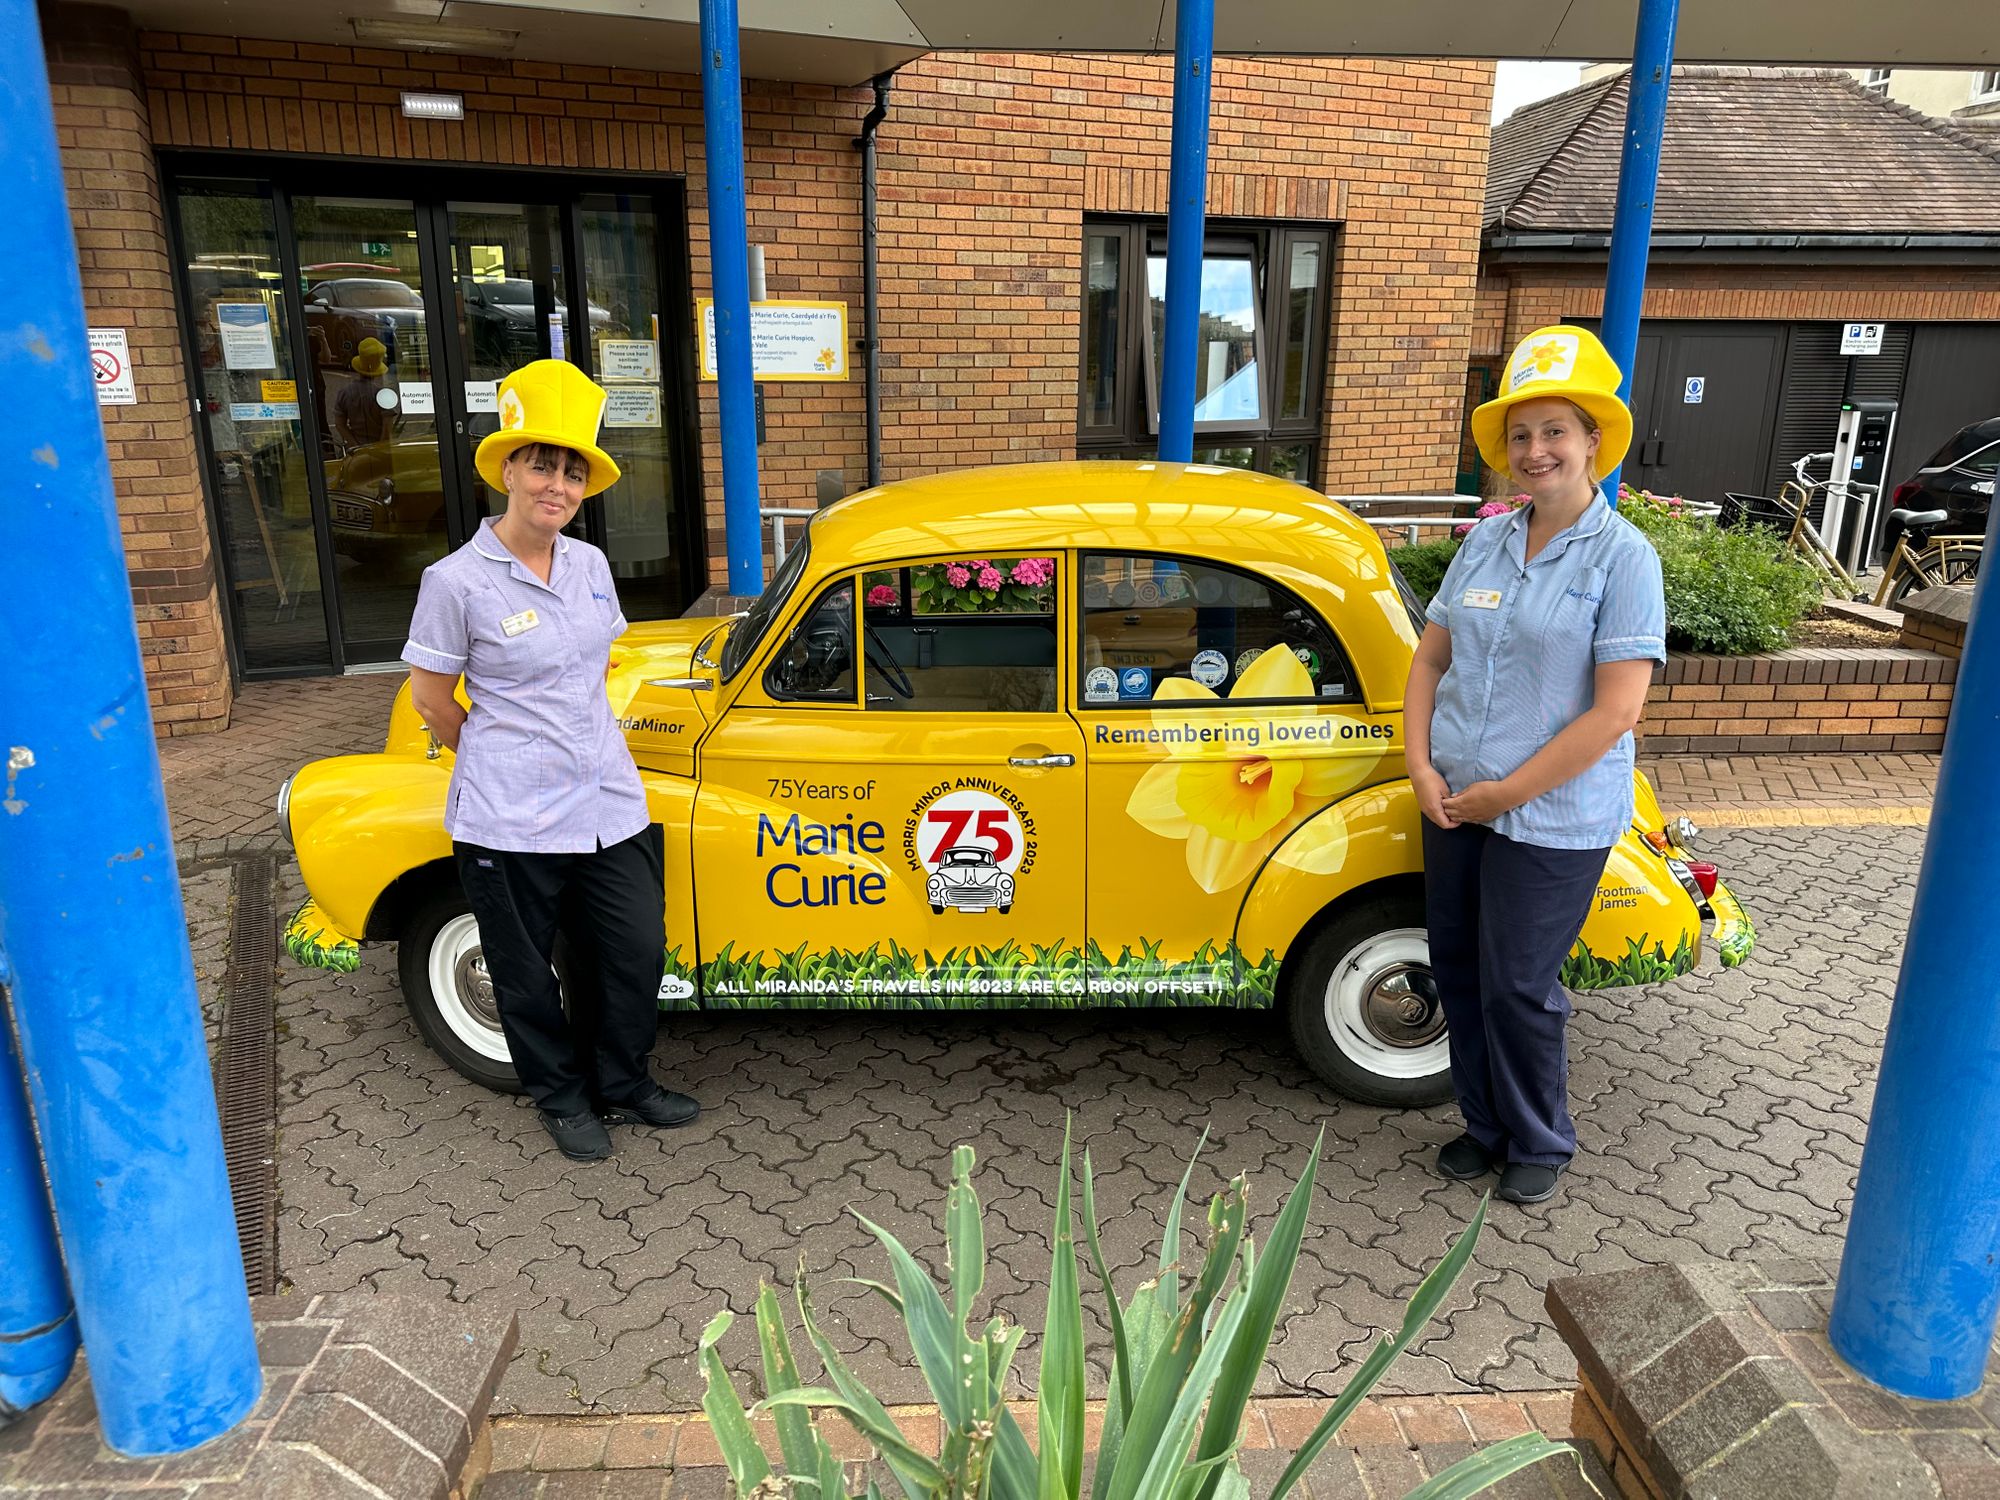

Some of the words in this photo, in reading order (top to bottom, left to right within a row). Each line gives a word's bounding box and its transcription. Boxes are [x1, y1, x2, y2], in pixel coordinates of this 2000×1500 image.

[1095, 722, 1260, 746] Remembering
[1269, 720, 1331, 741] loved
[1340, 723, 1394, 739] ones
[854, 780, 876, 800] of
[911, 781, 952, 816] MINOR
[955, 777, 1037, 837] ANNIVERSARY
[757, 813, 885, 857] Marie
[903, 818, 920, 872] MORRIS
[928, 810, 1013, 863] 75
[1020, 842, 1037, 874] 2023
[766, 863, 886, 908] Curie
[1597, 886, 1648, 898] Footman
[1598, 898, 1637, 912] James
[715, 981, 750, 993] ALL
[755, 980, 853, 993] MIRANDA'S
[861, 980, 941, 993] TRAVELS
[946, 981, 964, 993] IN
[969, 981, 1012, 993] 2023
[1018, 981, 1054, 993] ARE
[1144, 980, 1223, 994] OFFSET!
